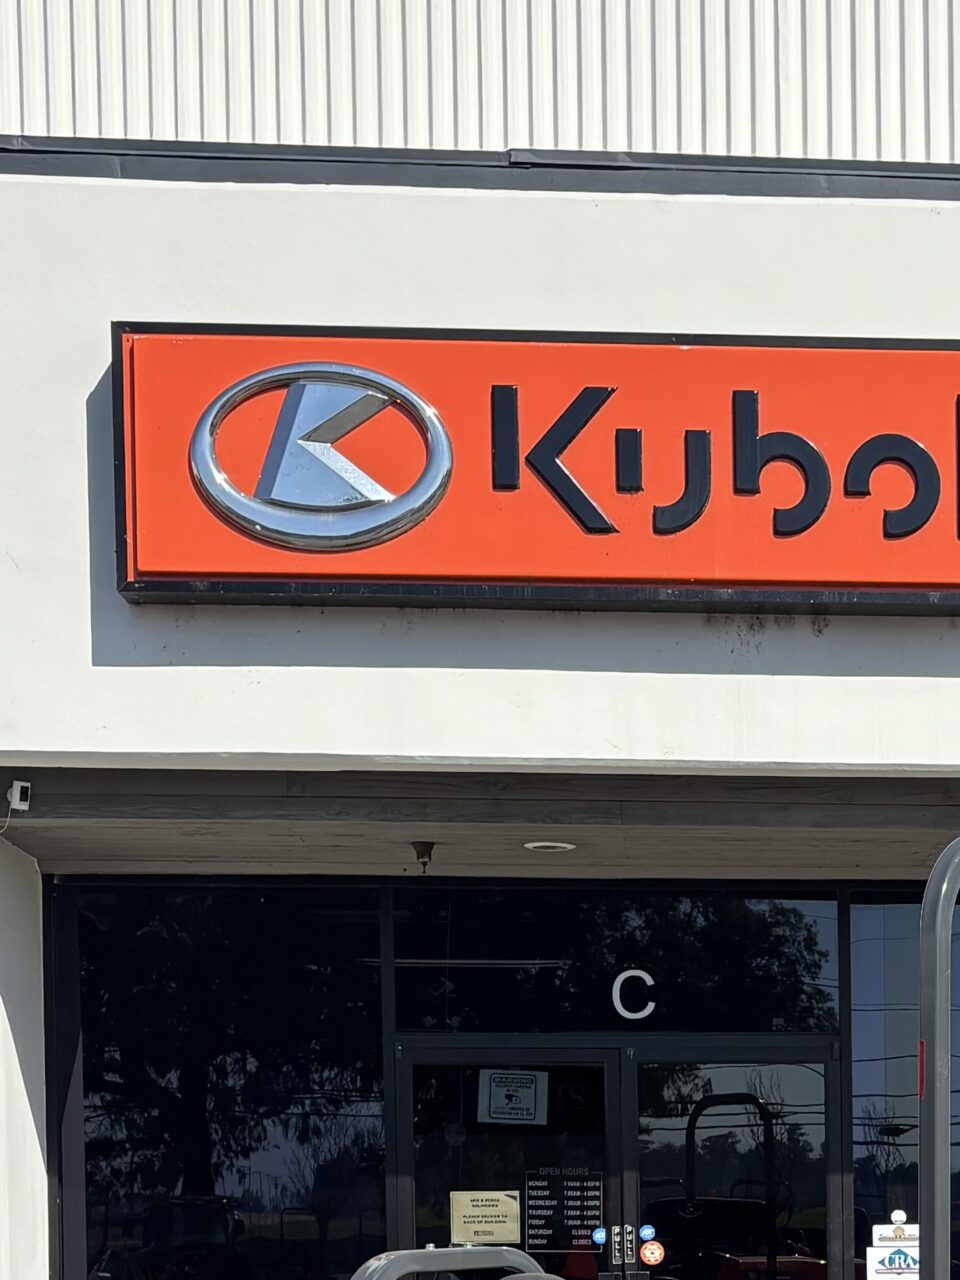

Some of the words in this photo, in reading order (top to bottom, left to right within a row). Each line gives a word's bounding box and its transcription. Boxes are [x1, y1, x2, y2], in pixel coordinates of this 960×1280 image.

[612, 969, 656, 1019] C
[539, 1167, 560, 1176] OPEN
[562, 1167, 589, 1176] HOURS
[884, 1254, 914, 1269] CRA
